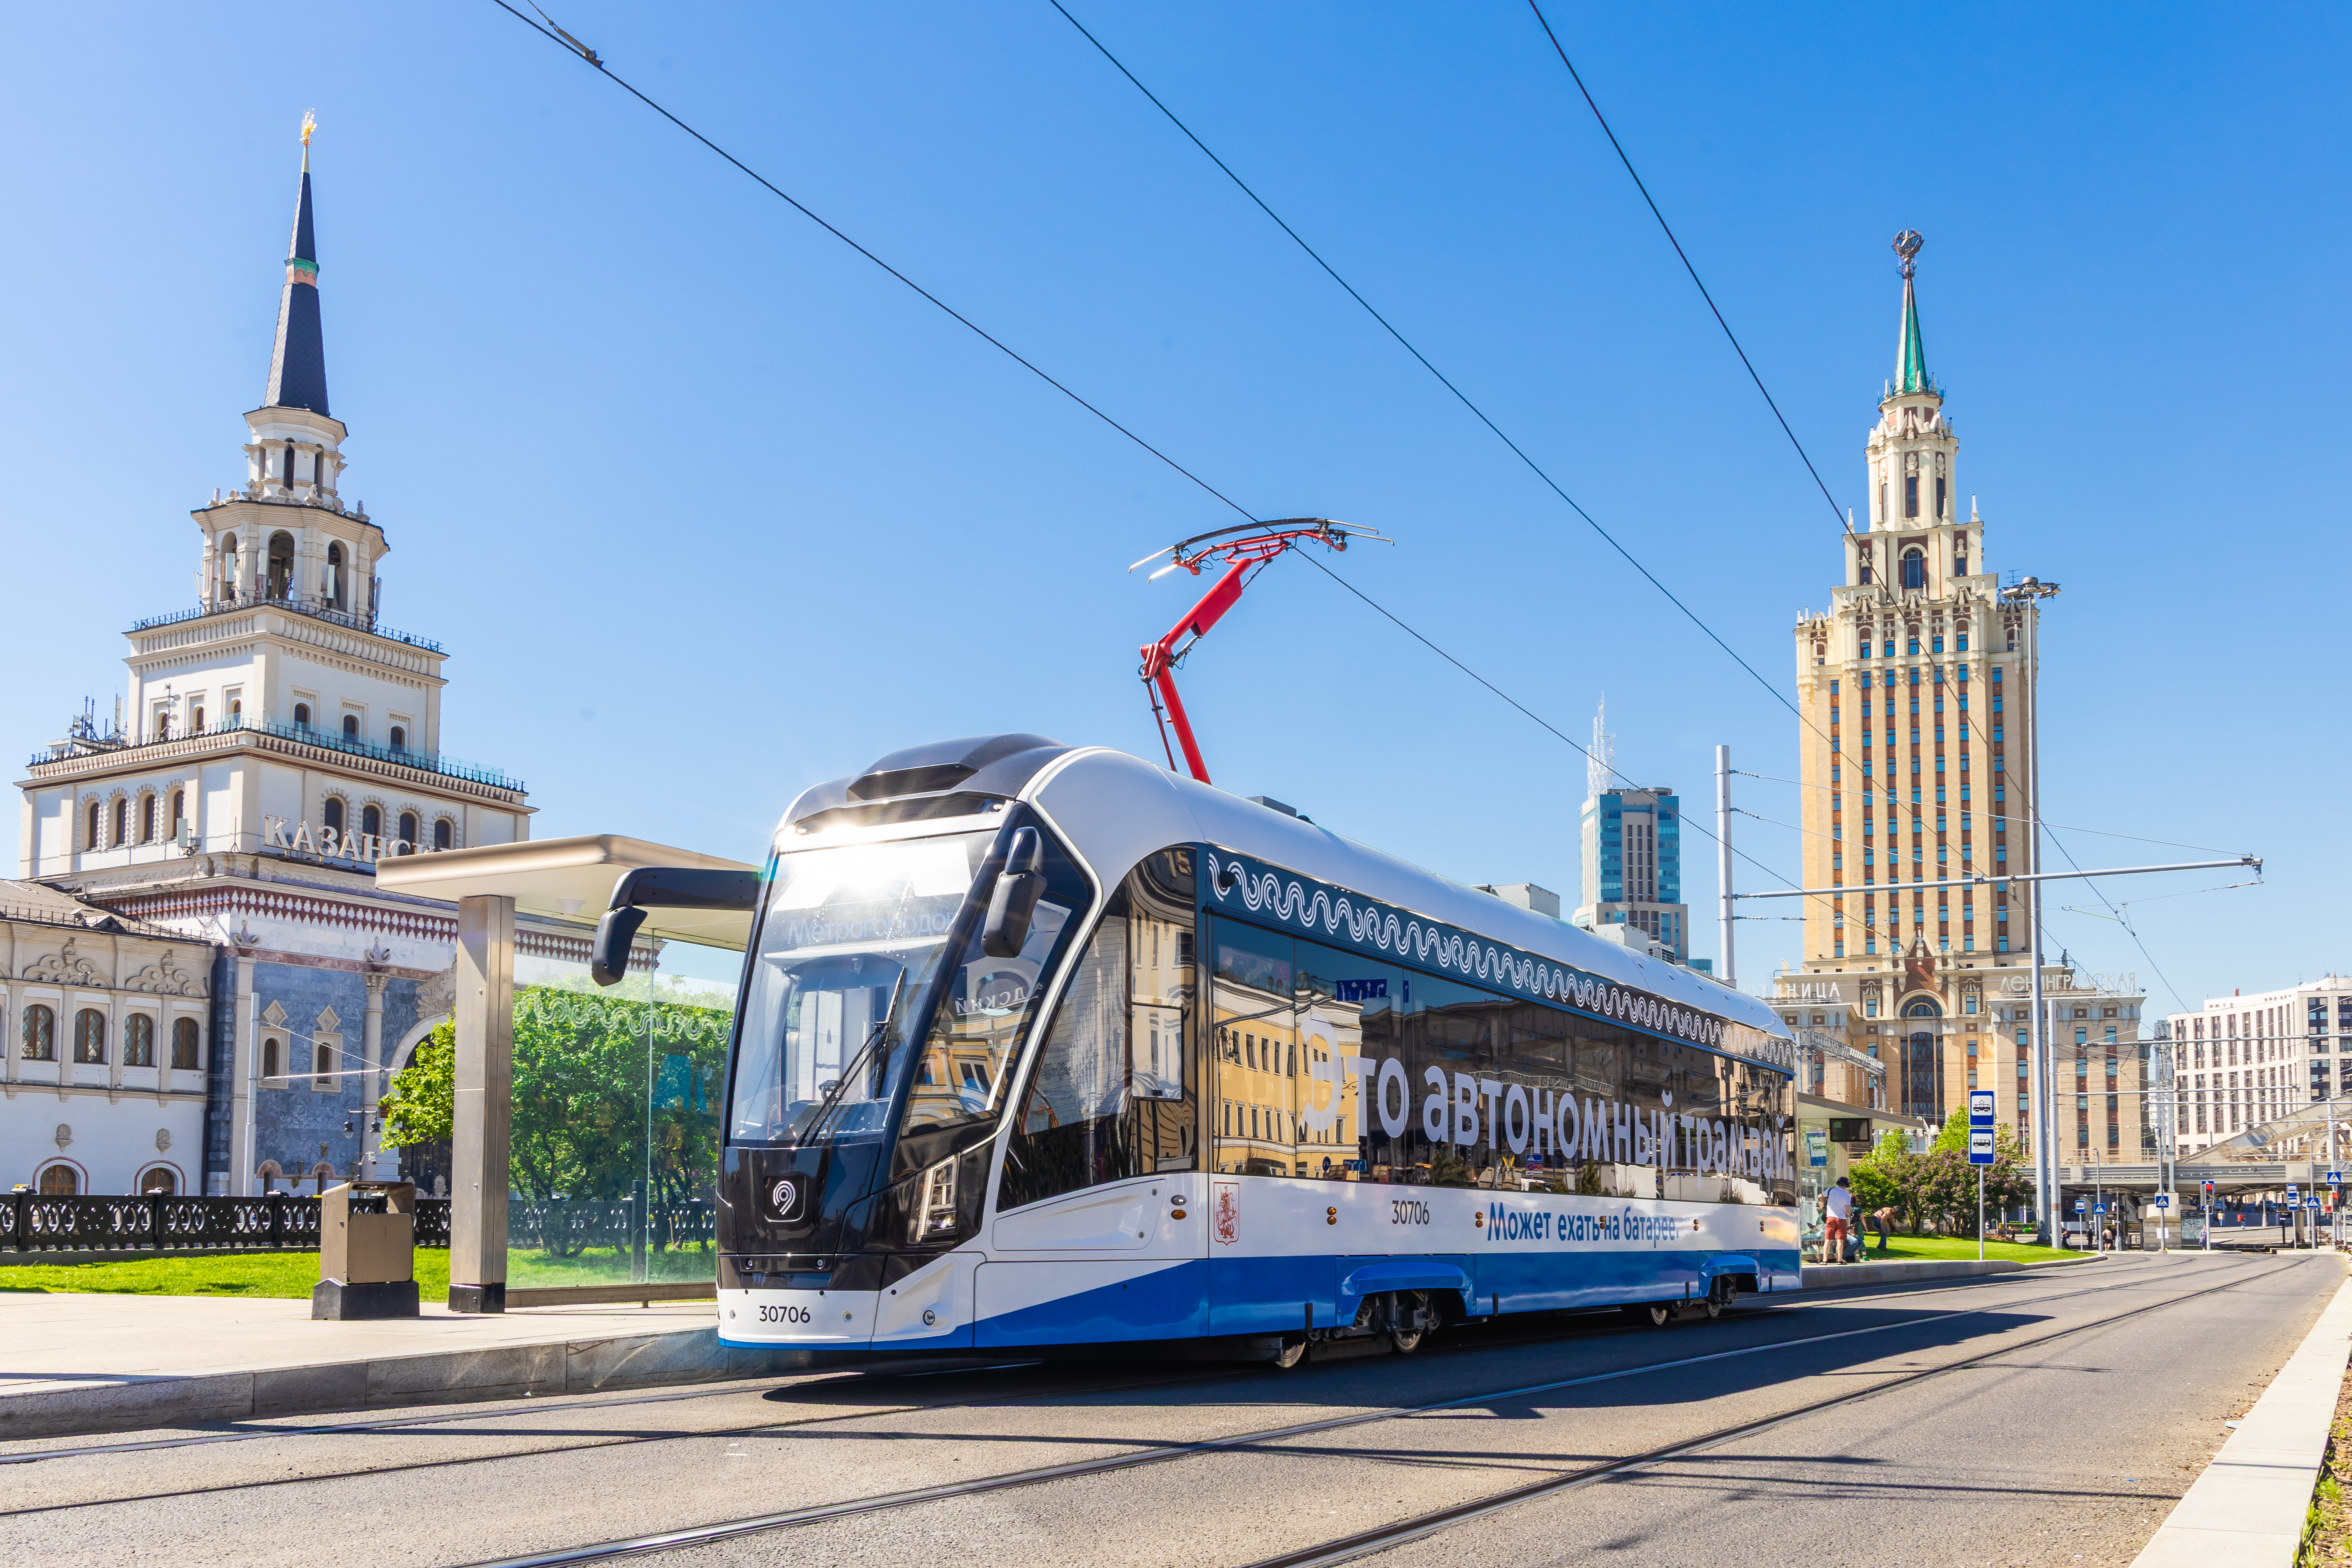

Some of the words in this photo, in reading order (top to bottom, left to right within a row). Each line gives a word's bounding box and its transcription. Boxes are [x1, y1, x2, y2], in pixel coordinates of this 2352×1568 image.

[263, 814, 450, 863] КАЗАНС
[1300, 1013, 1409, 1138] Это
[1423, 1066, 1676, 1169] автономный
[1681, 1115, 1793, 1190] трамвай.
[1392, 1200, 1429, 1225] 30706
[1487, 1202, 1551, 1241] Может
[1558, 1215, 1600, 1241] ехать
[1604, 1215, 1619, 1240] на
[1624, 1206, 1679, 1248] батарее.
[759, 1306, 810, 1323] 30706
